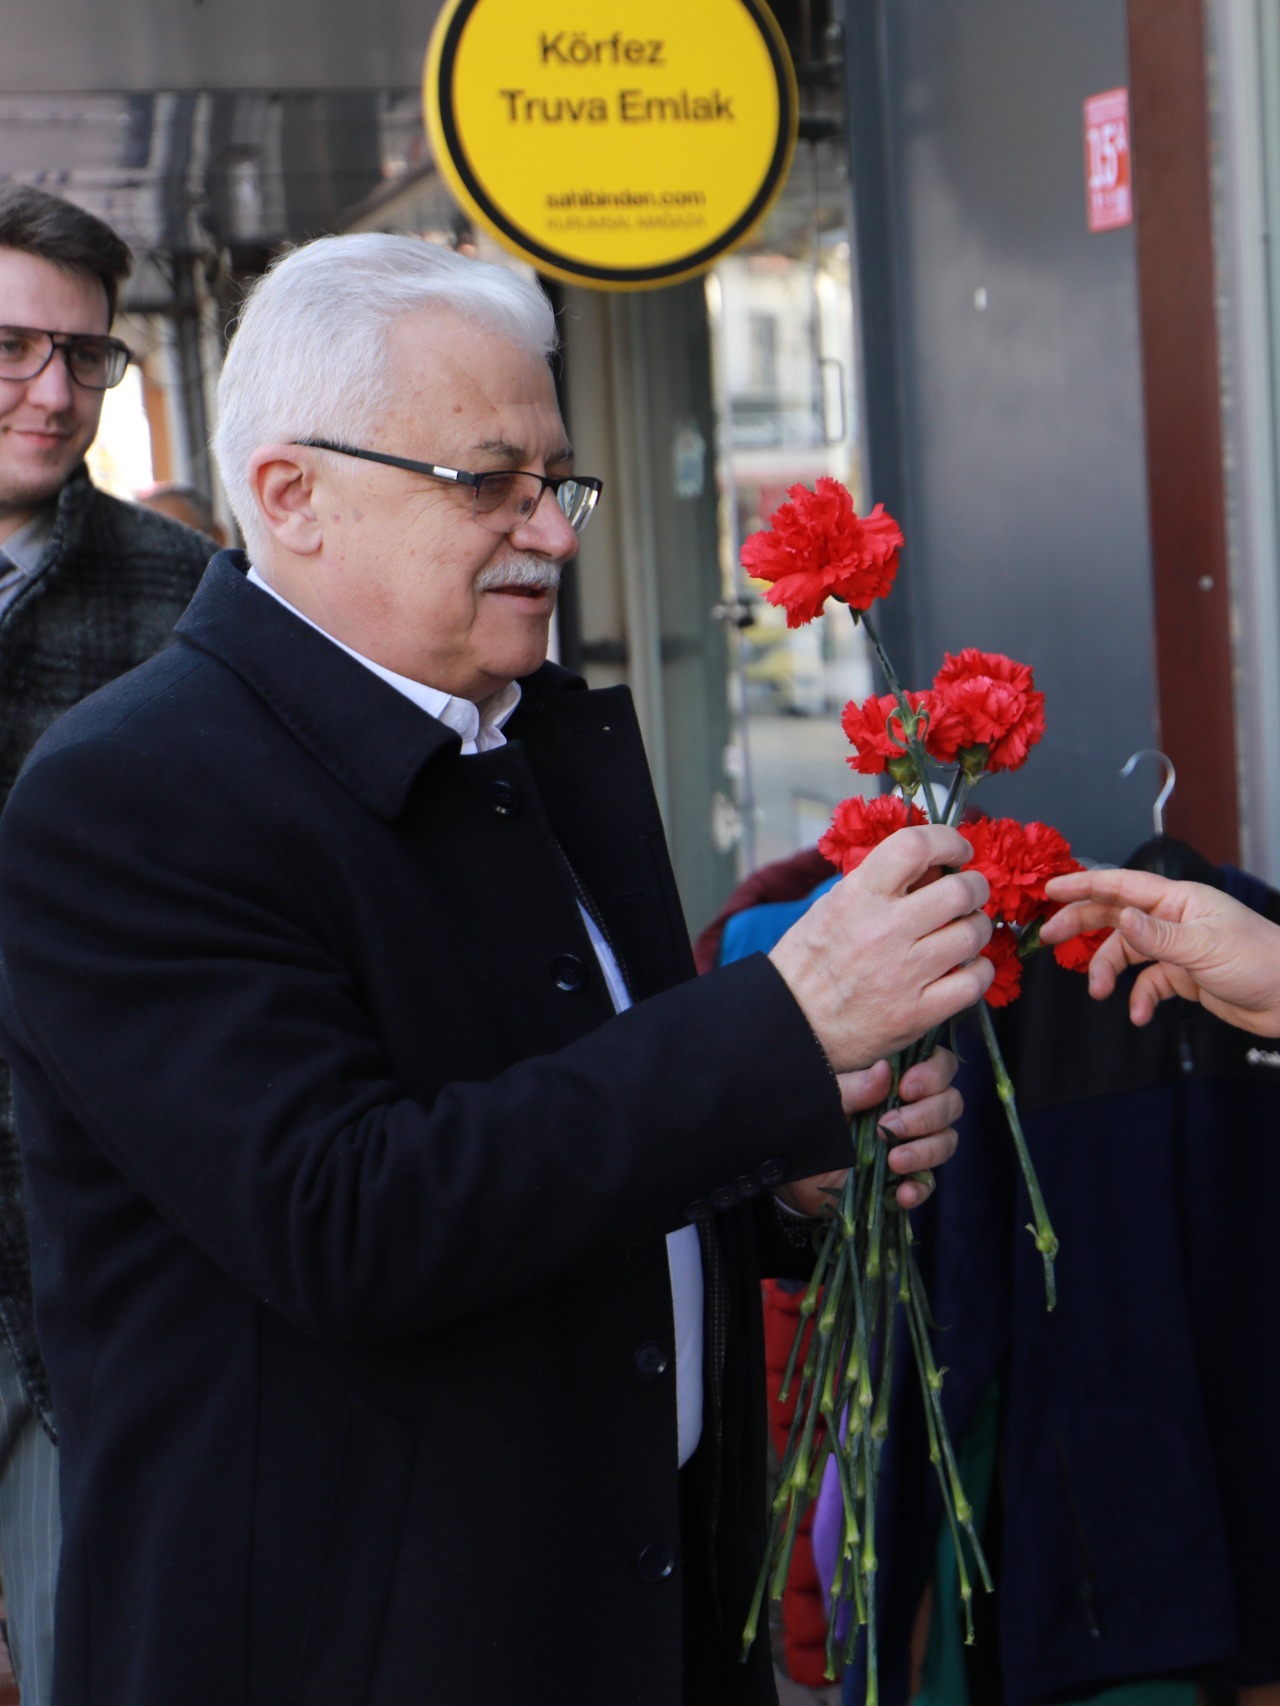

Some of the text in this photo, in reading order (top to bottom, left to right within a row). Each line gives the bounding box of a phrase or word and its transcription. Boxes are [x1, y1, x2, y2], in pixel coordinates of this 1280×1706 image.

[539, 31, 665, 64] Körfez
[500, 89, 735, 122] Truva Emlak
[546, 189, 705, 208] sahibinden.com
